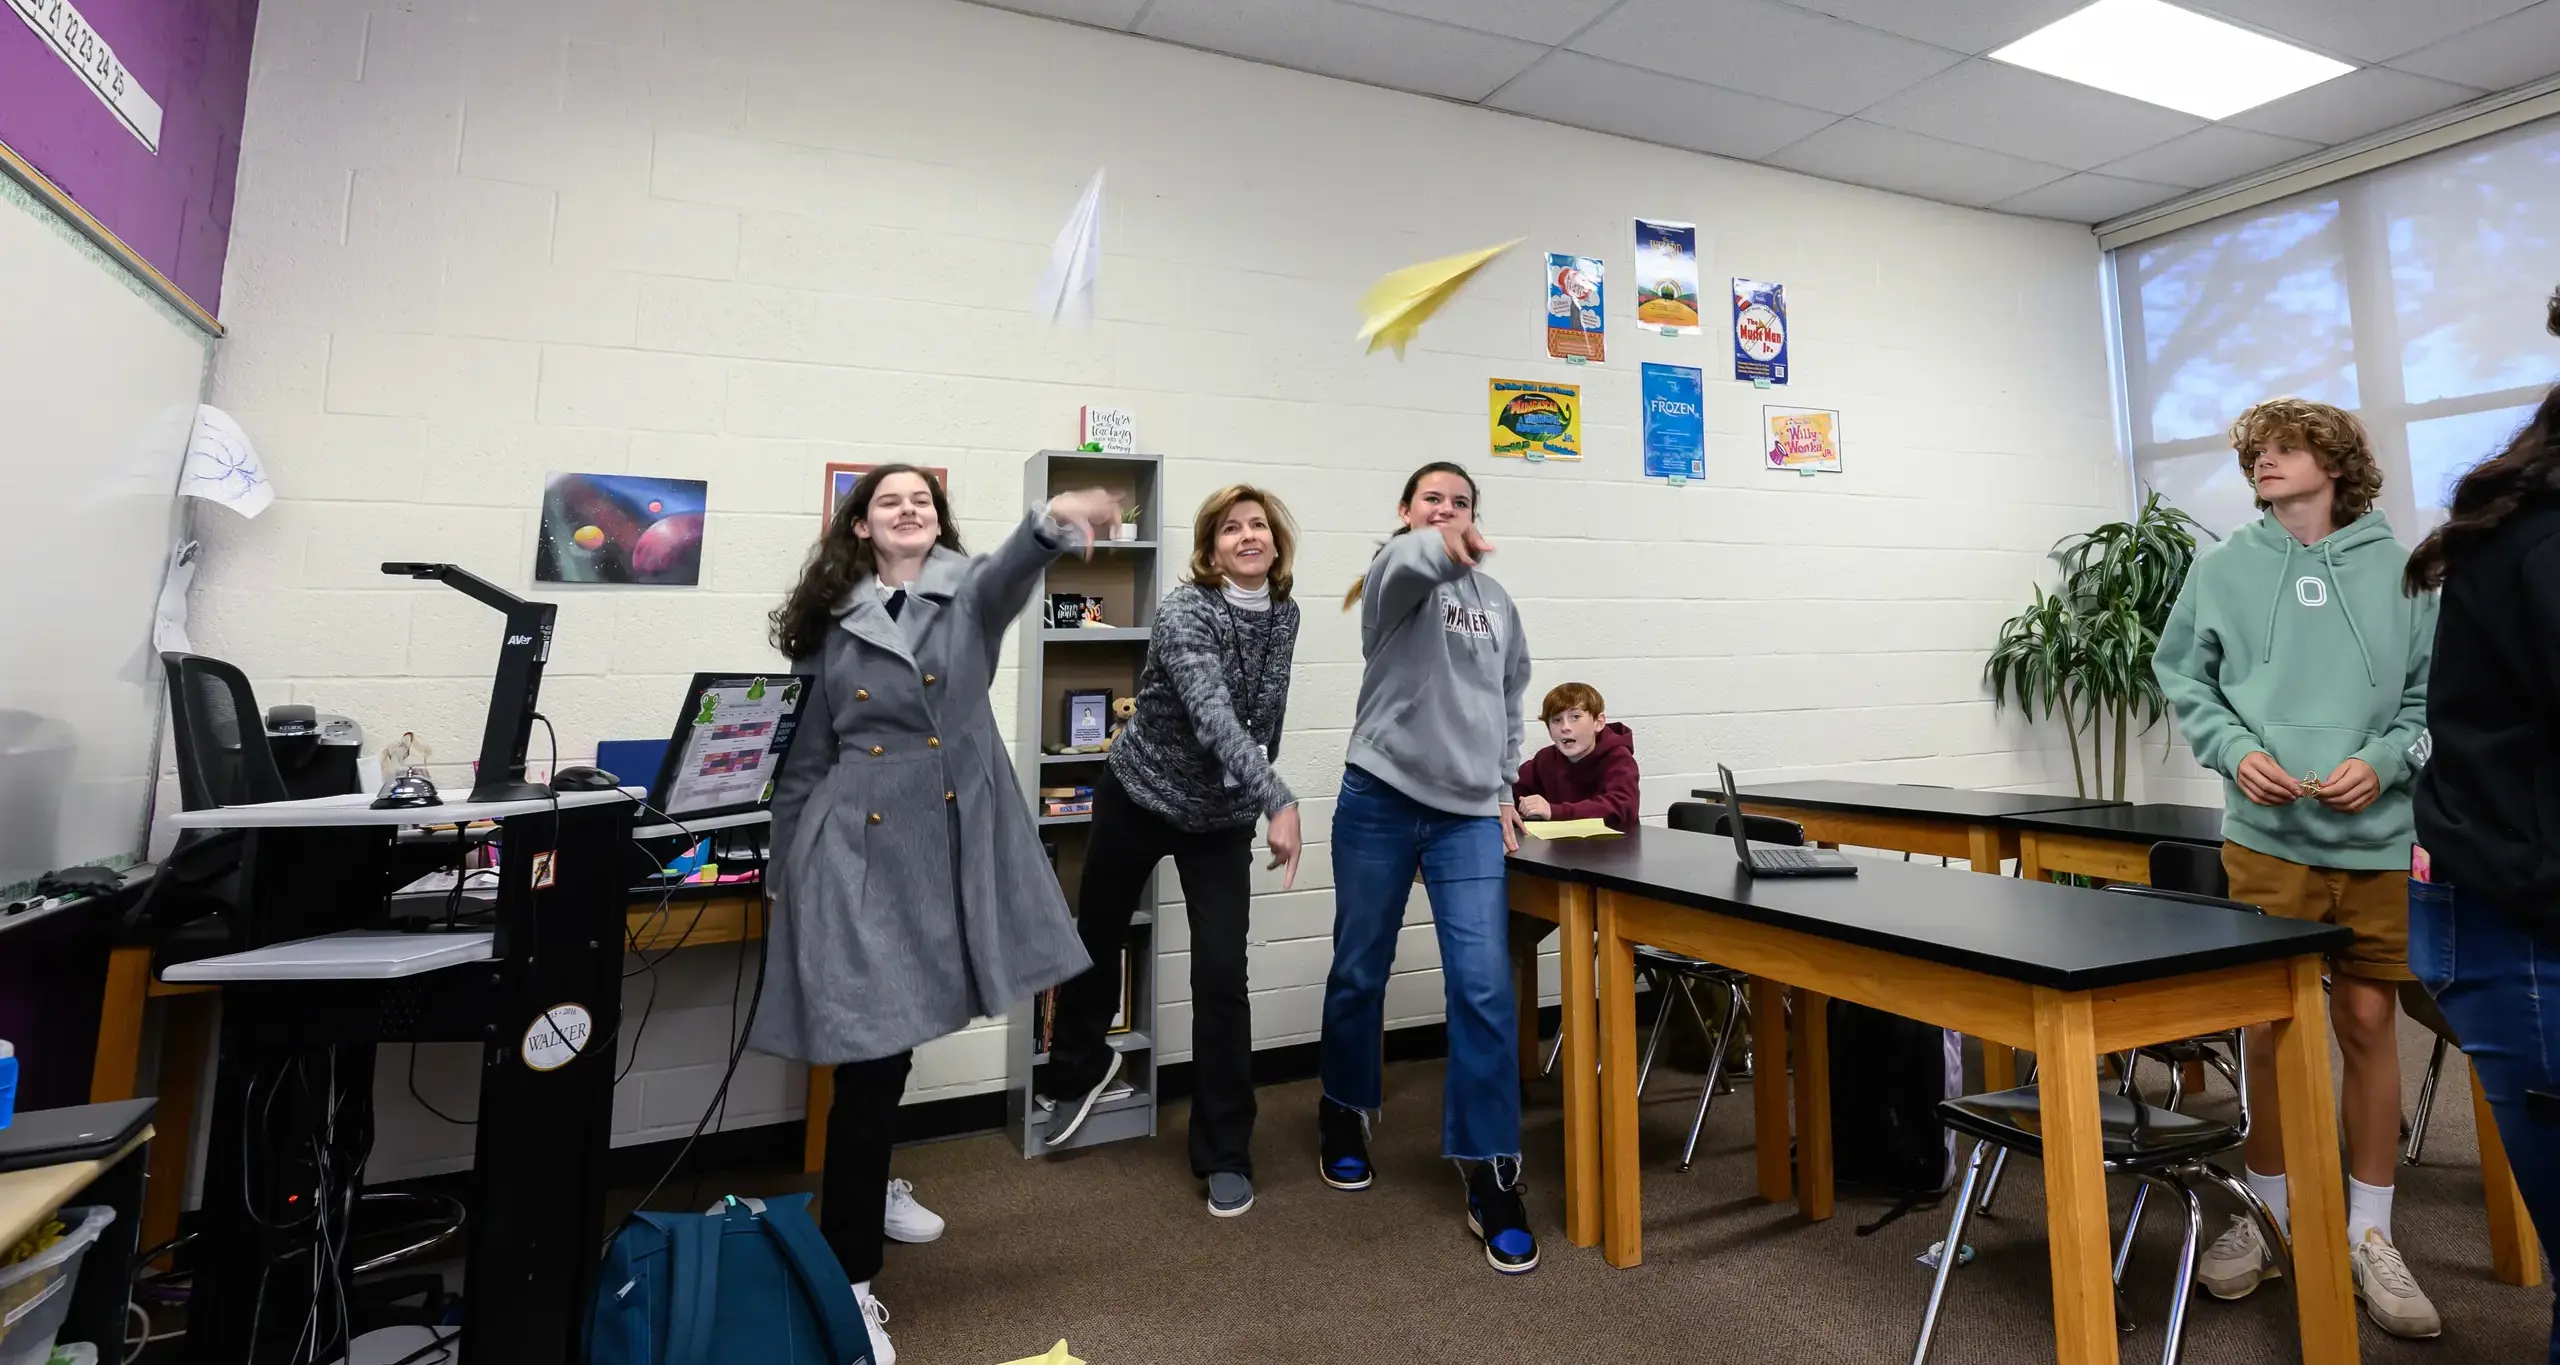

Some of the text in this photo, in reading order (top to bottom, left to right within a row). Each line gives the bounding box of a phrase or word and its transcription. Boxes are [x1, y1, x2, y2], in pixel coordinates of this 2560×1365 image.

[49, 0, 124, 97] 21 22 23 24 25
[1747, 318, 1759, 326] The
[1764, 328, 1782, 344] Man
[1763, 343, 1774, 353] Jr.
[1652, 400, 1696, 418] FROZEN
[1786, 425, 1817, 442] Willy
[1784, 441, 1822, 454] Wonka
[563, 1008, 577, 1016] 2016
